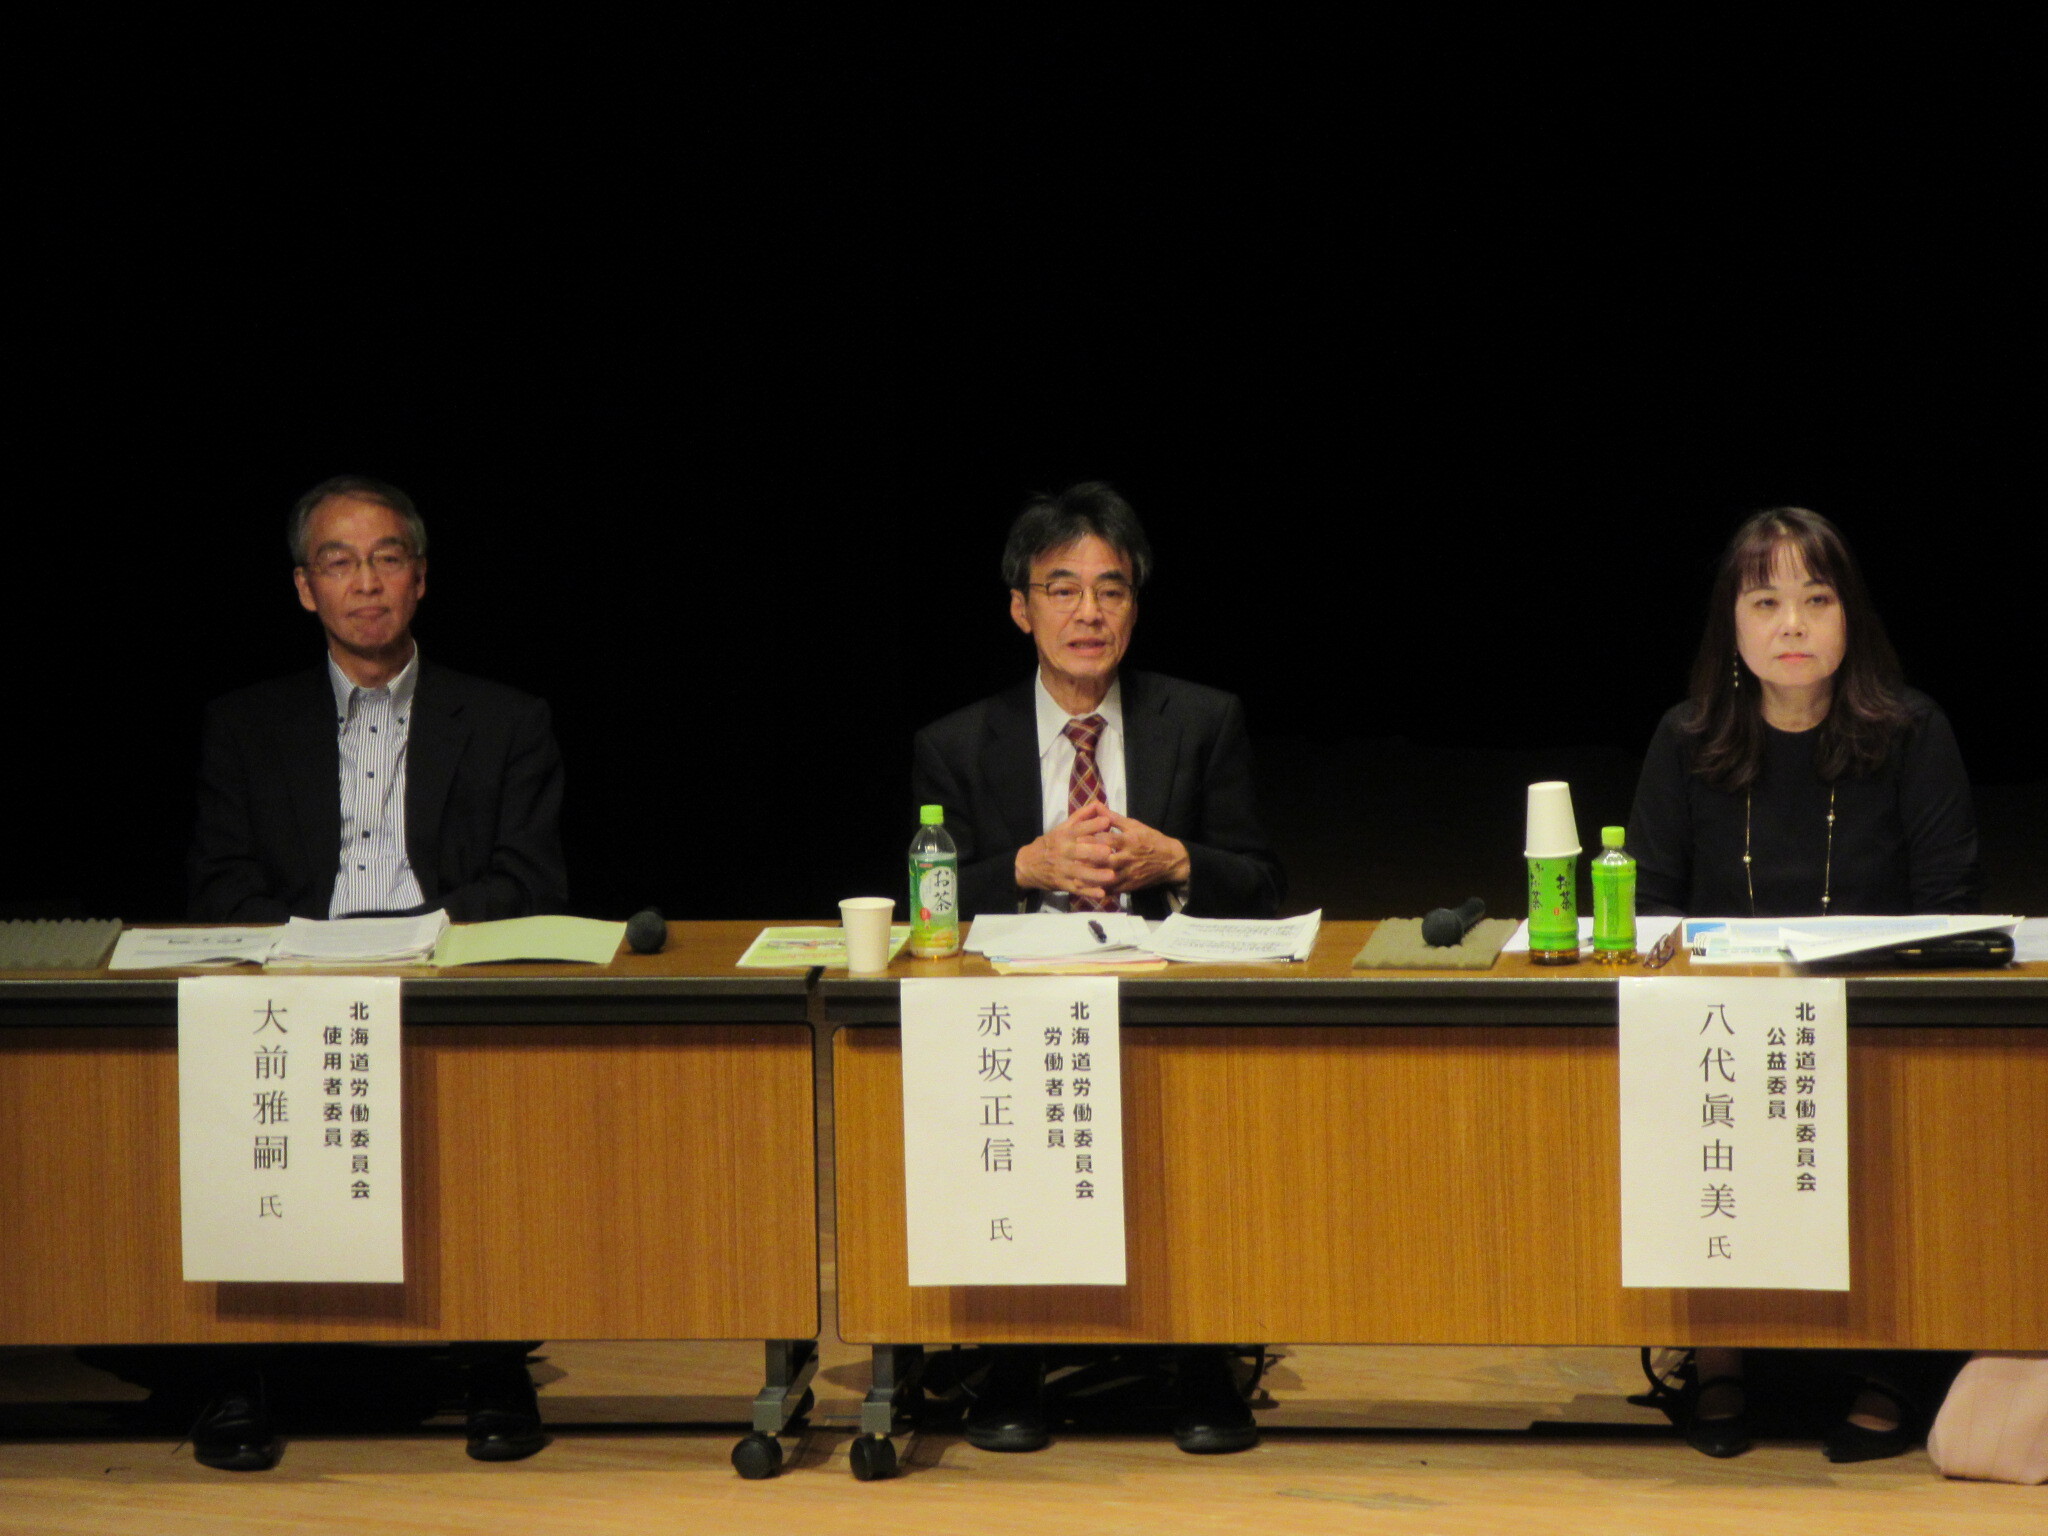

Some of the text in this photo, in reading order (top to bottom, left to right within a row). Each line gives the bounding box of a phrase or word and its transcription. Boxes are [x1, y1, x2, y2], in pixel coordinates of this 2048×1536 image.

[934, 870, 952, 911] お茶
[252, 998, 289, 1219] 大前雅嗣 氏
[322, 1025, 343, 1148] 使用者委員
[349, 1001, 371, 1200] 北海道労働委員会
[977, 1001, 1015, 1242] 赤坂正信 氏
[1043, 1026, 1066, 1149] 労働者委員
[1070, 1001, 1095, 1200] 北海道労働委員会
[1766, 1026, 1788, 1120] 公益委員
[1795, 1001, 1817, 1192] 北海道労働委員会
